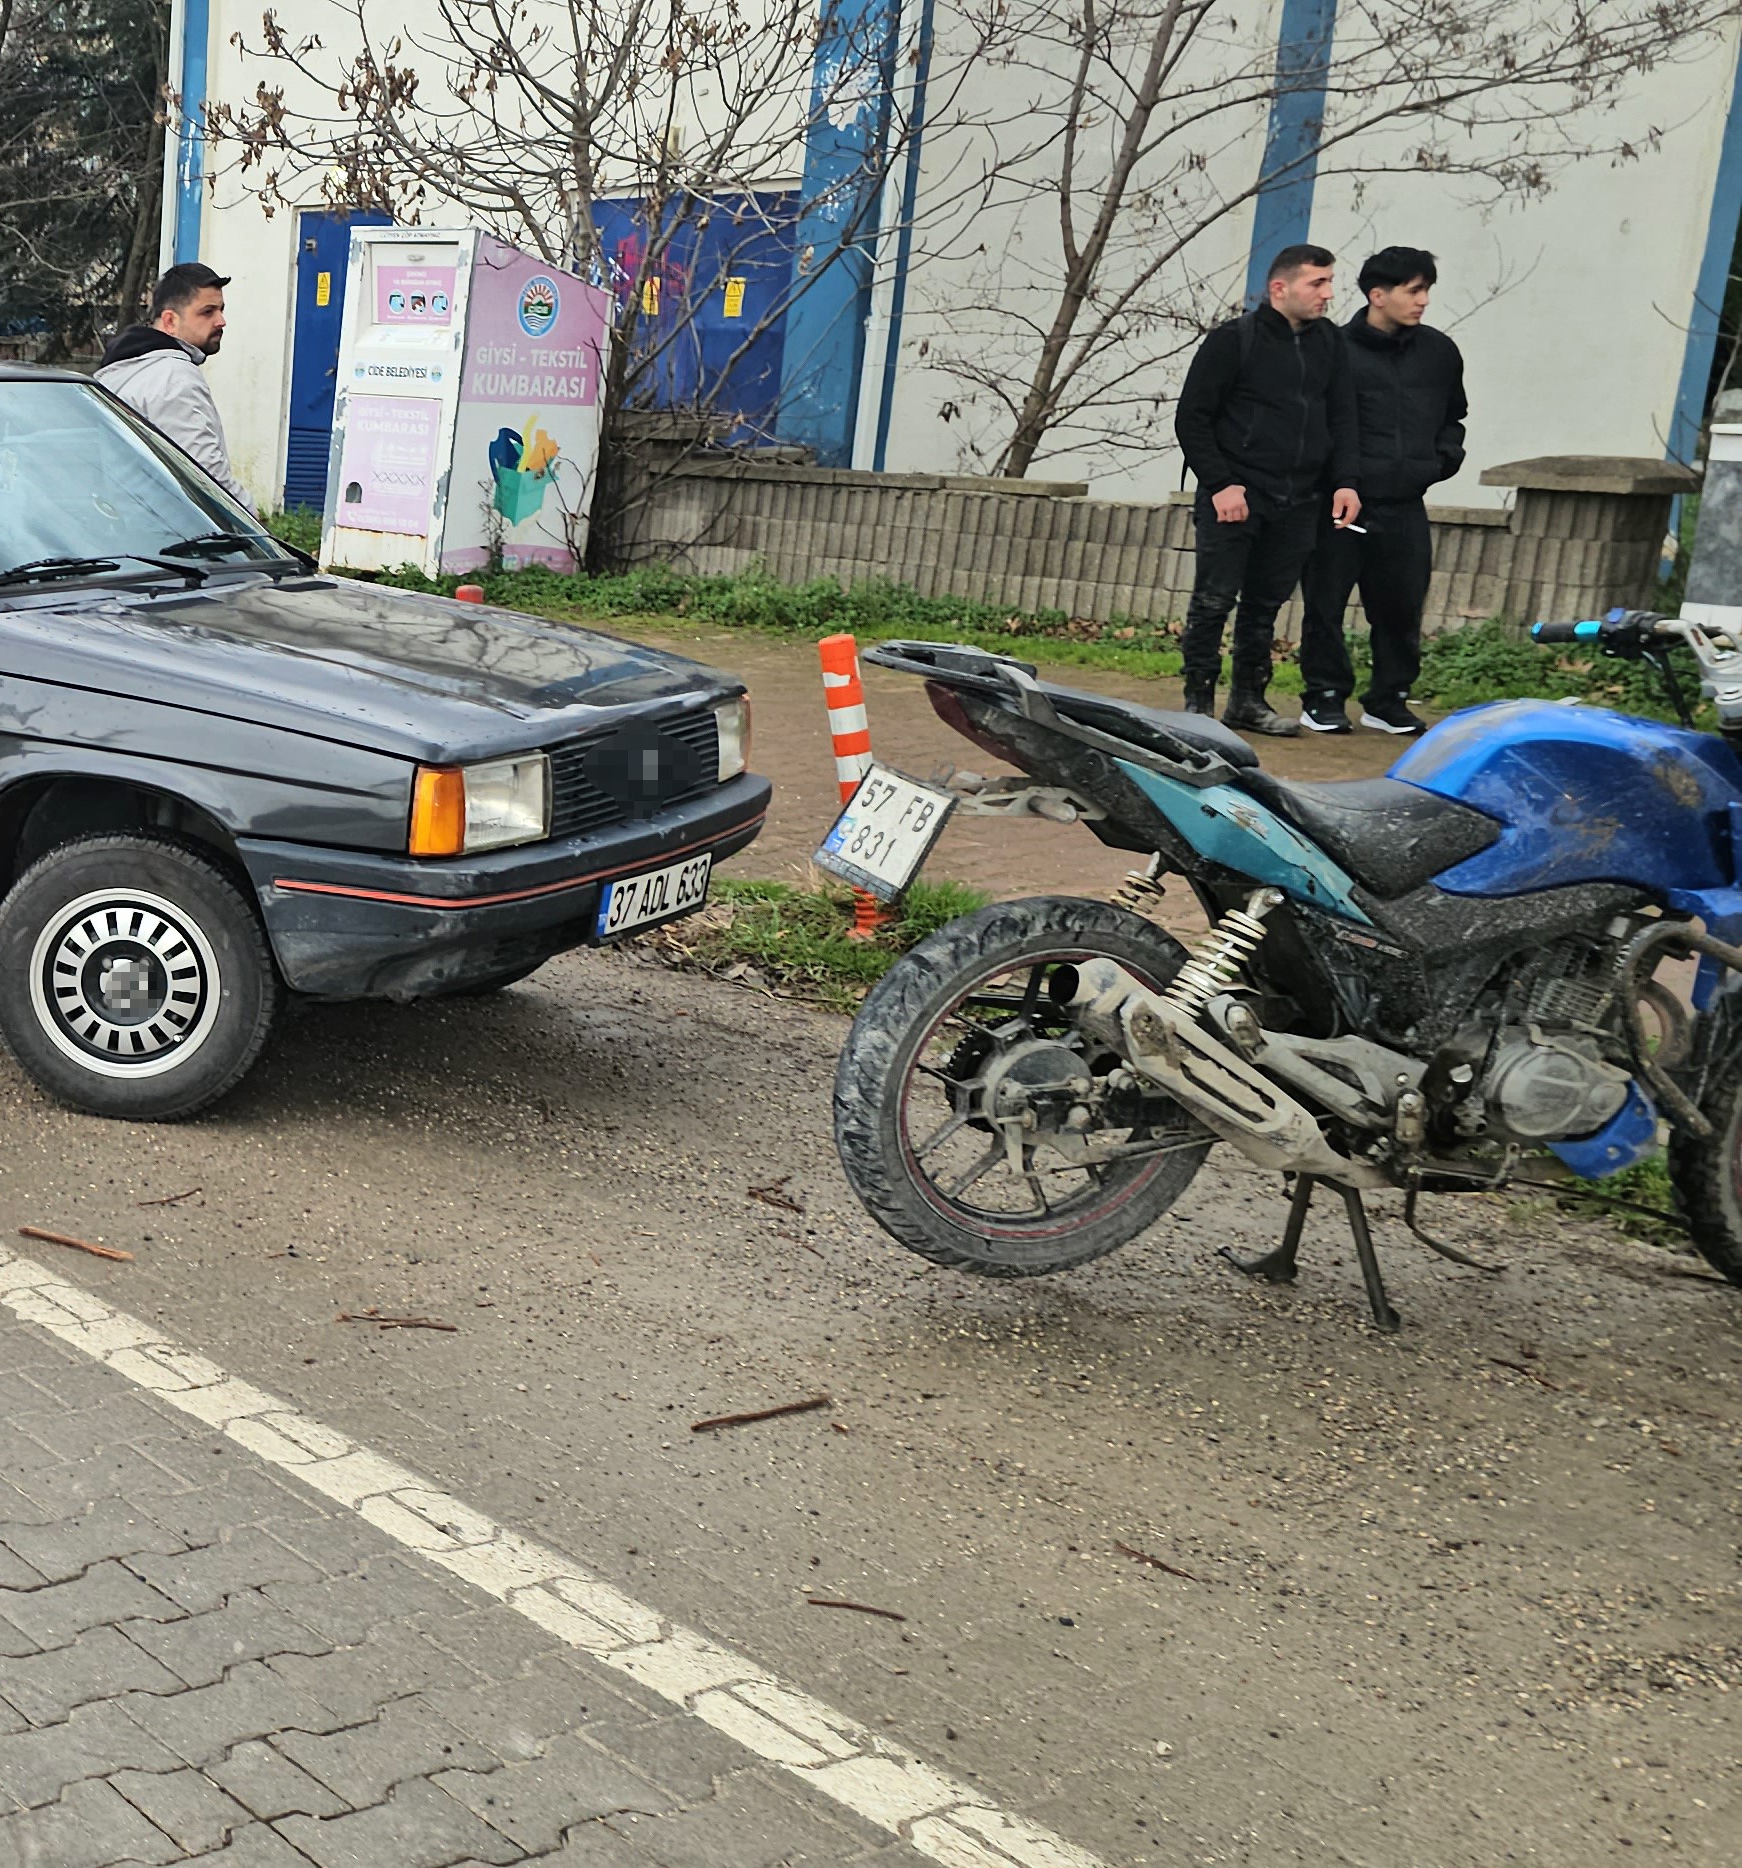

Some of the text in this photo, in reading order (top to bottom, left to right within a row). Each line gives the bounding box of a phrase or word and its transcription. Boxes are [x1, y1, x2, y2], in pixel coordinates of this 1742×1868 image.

[475, 341, 517, 366] GİYSİ
[530, 345, 588, 369] TEKSTİL
[471, 371, 586, 399] KUMBARASI
[357, 420, 429, 436] KUMBARASI
[861, 778, 935, 832] 57 FB
[851, 825, 898, 867] 831
[610, 859, 707, 927] 37 ADL 633
